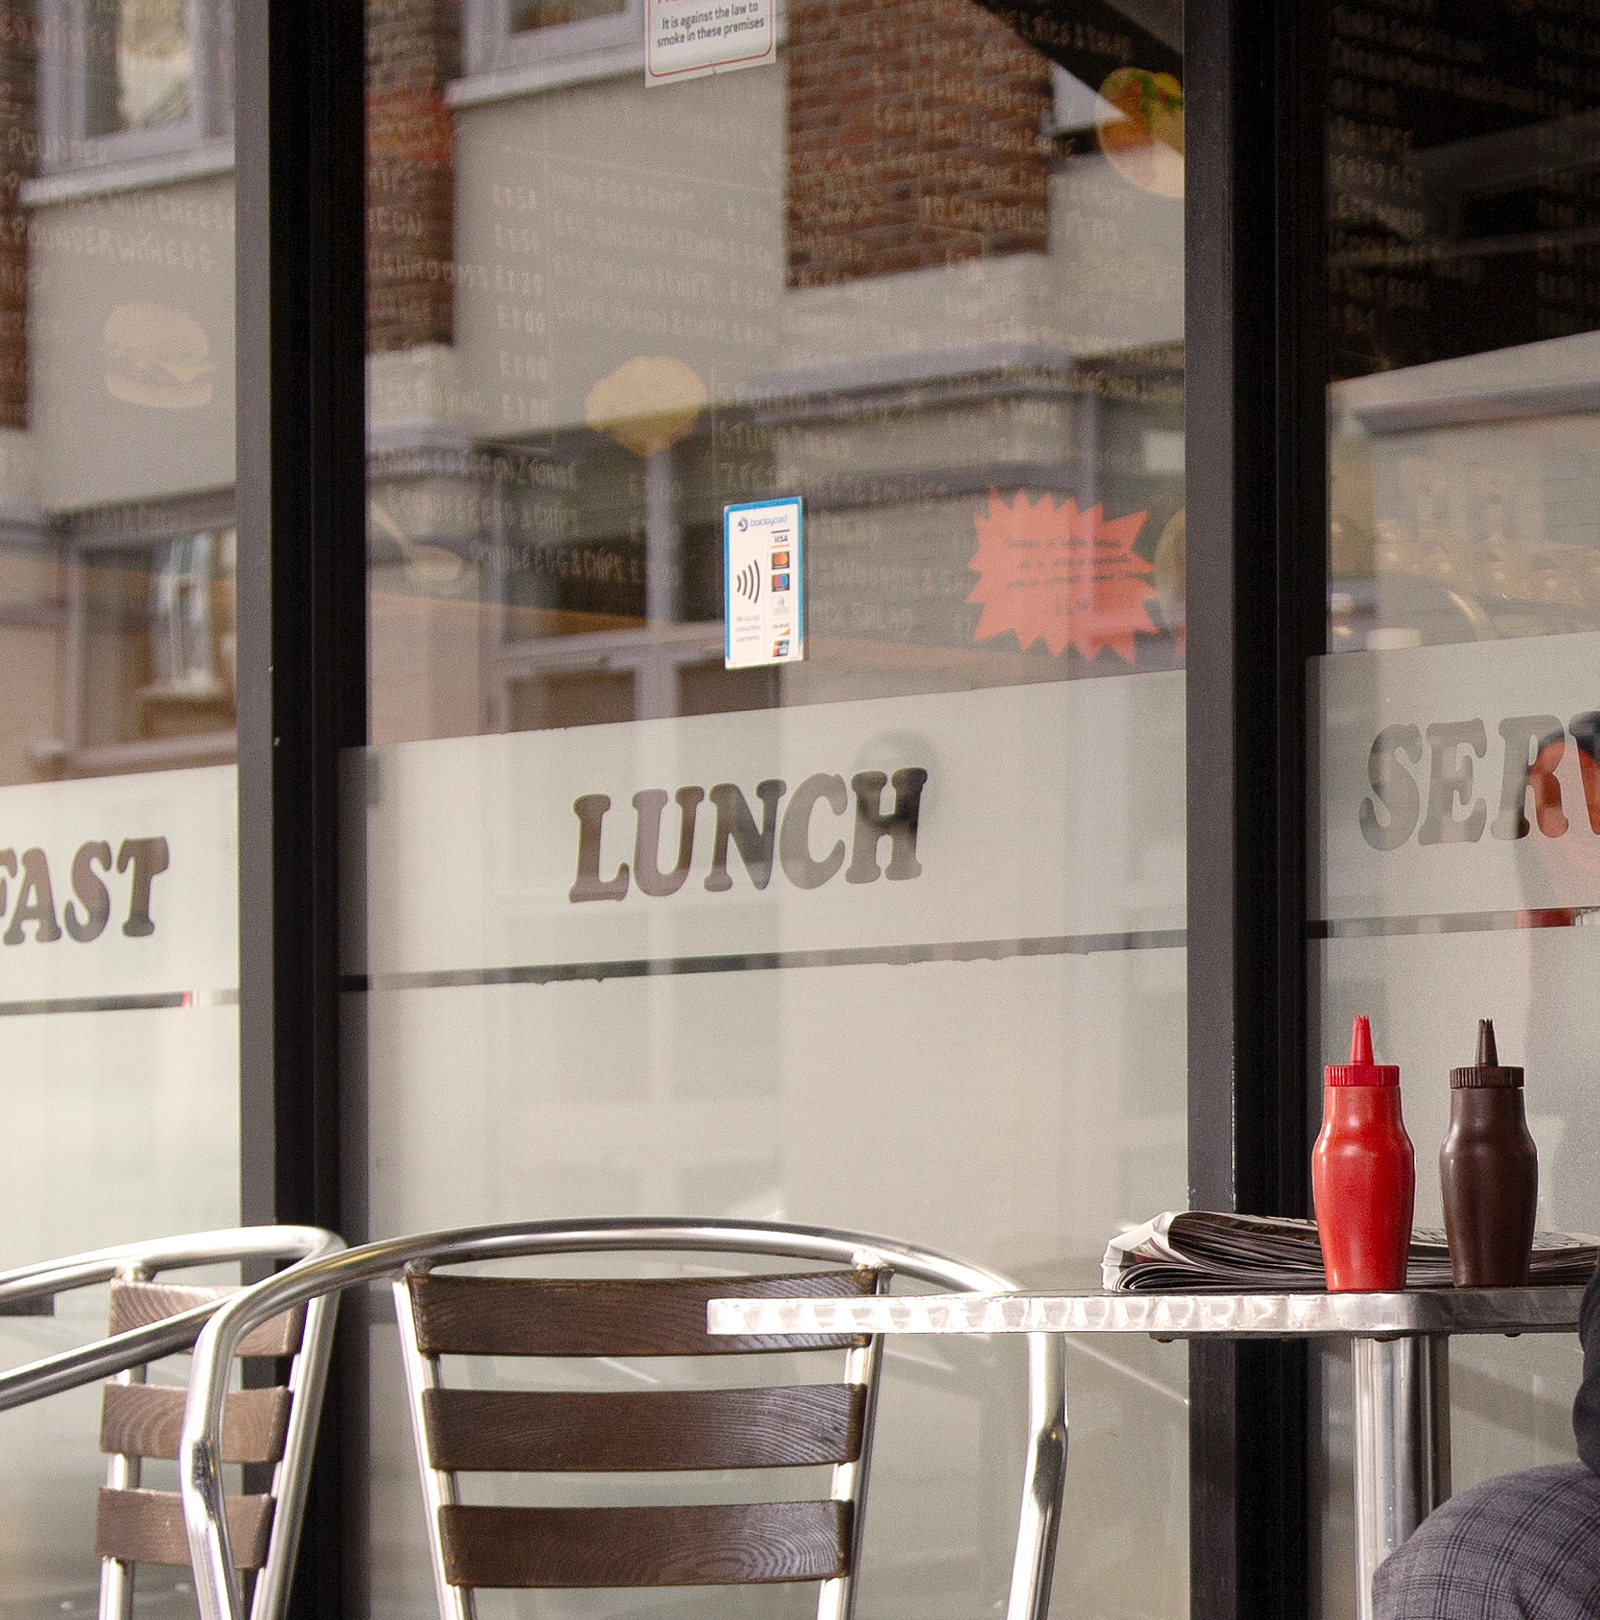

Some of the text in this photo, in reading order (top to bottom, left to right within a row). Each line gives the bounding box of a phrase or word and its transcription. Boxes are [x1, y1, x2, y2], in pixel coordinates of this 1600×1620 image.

[662, 2, 758, 29] It is against the law to
[657, 18, 764, 47] smoke in these premises
[774, 534, 788, 543] VISA
[569, 767, 929, 904] LUNCH
